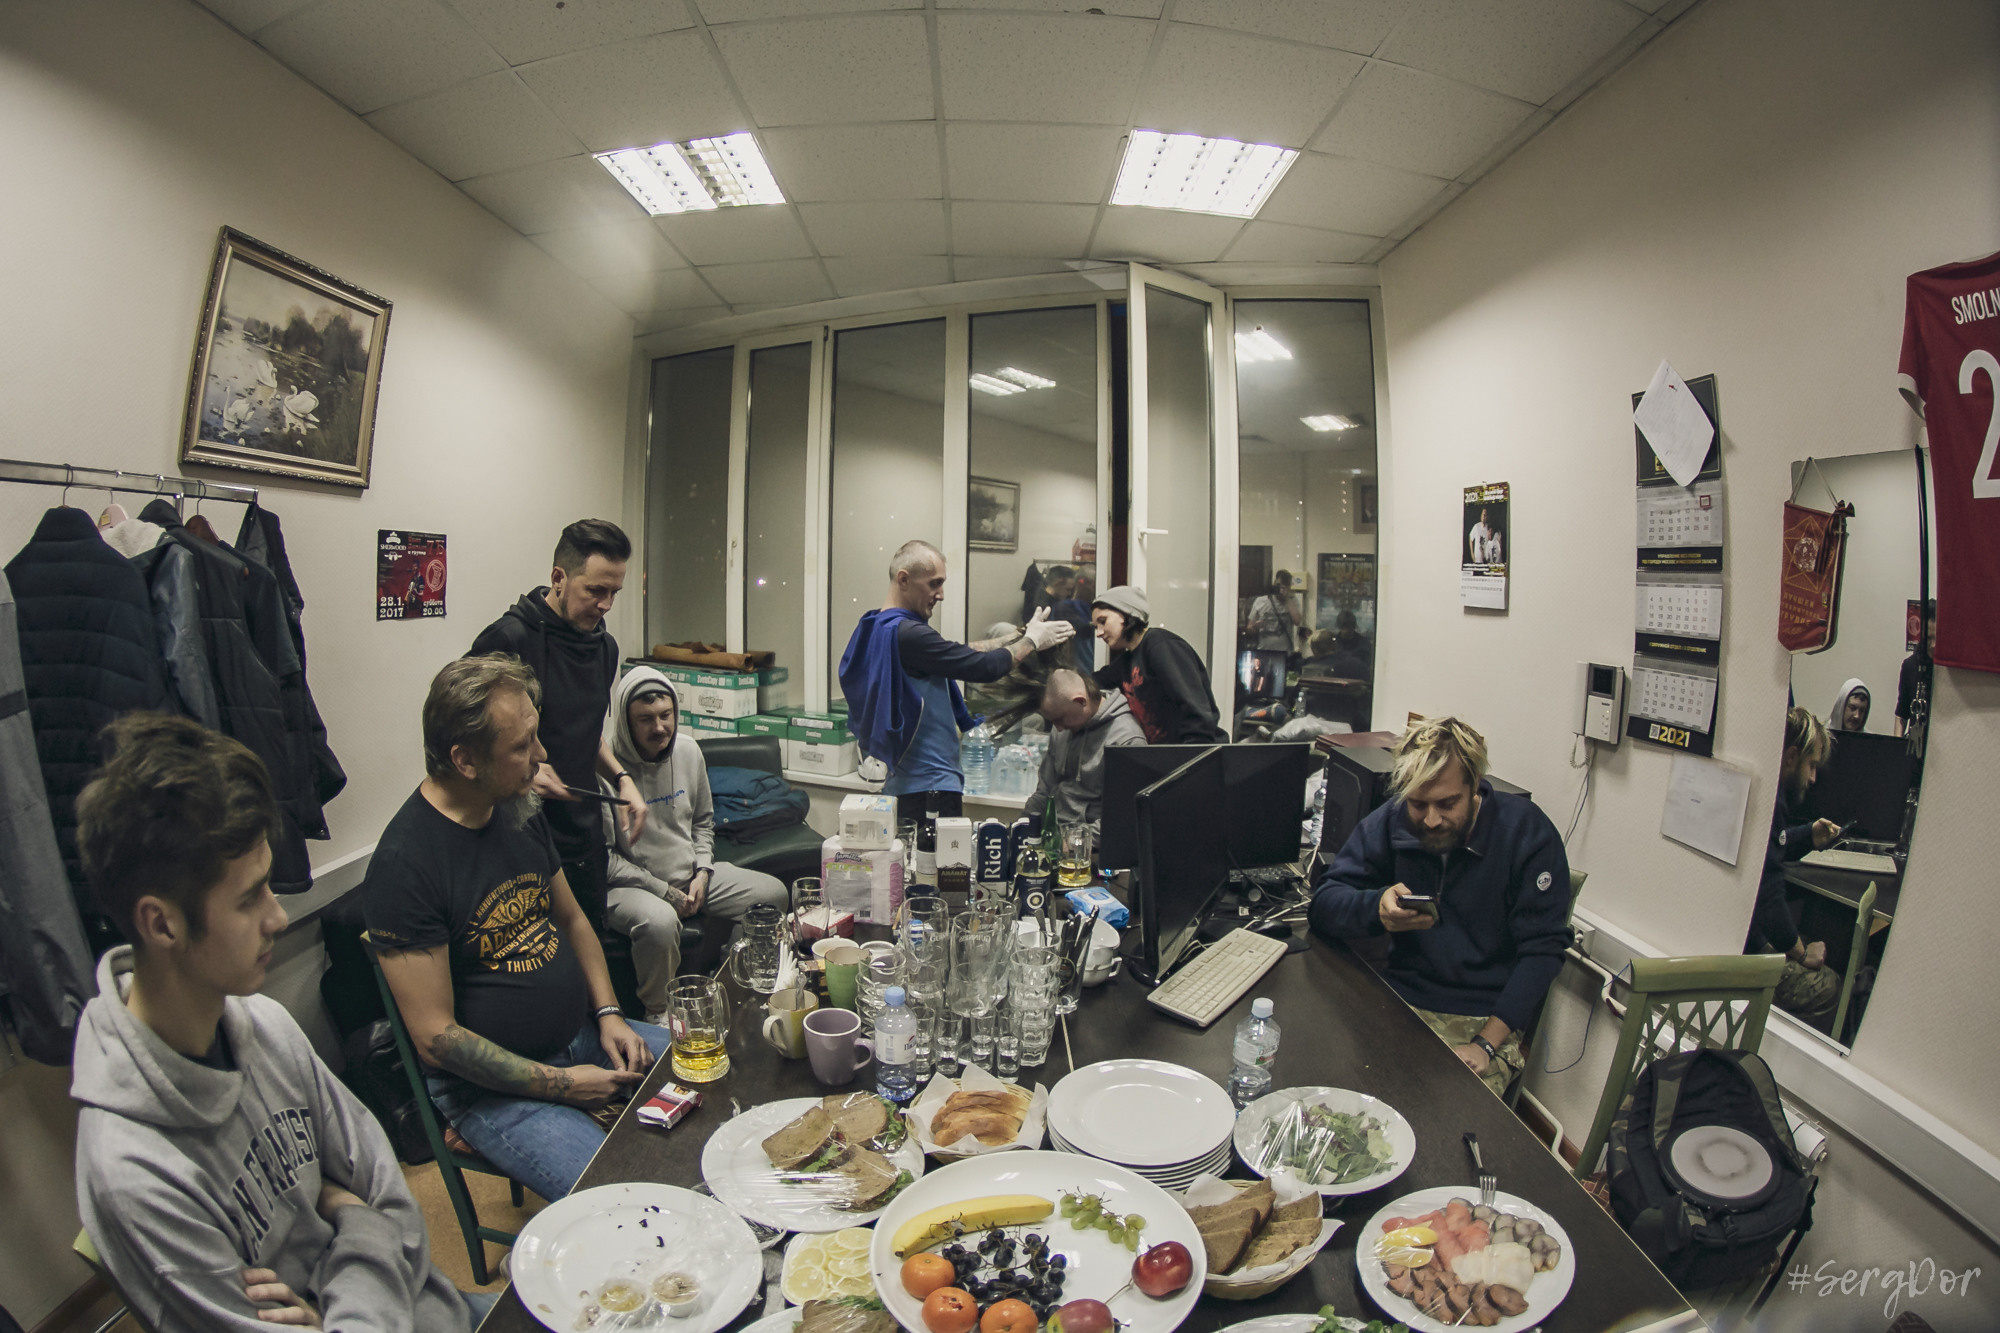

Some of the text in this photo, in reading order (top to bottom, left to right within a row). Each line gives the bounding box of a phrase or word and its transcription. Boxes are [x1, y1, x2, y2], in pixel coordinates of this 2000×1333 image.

[1951, 287, 2000, 325] SMOLN
[380, 596, 405, 607] 28.1.
[423, 599, 443, 607] суббота
[380, 607, 404, 618] 2017
[422, 607, 444, 616] 20.00
[1659, 726, 1691, 747] 2021
[984, 838, 1002, 879] Rich
[542, 934, 559, 962] YEARS
[507, 957, 543, 973] THIRTY
